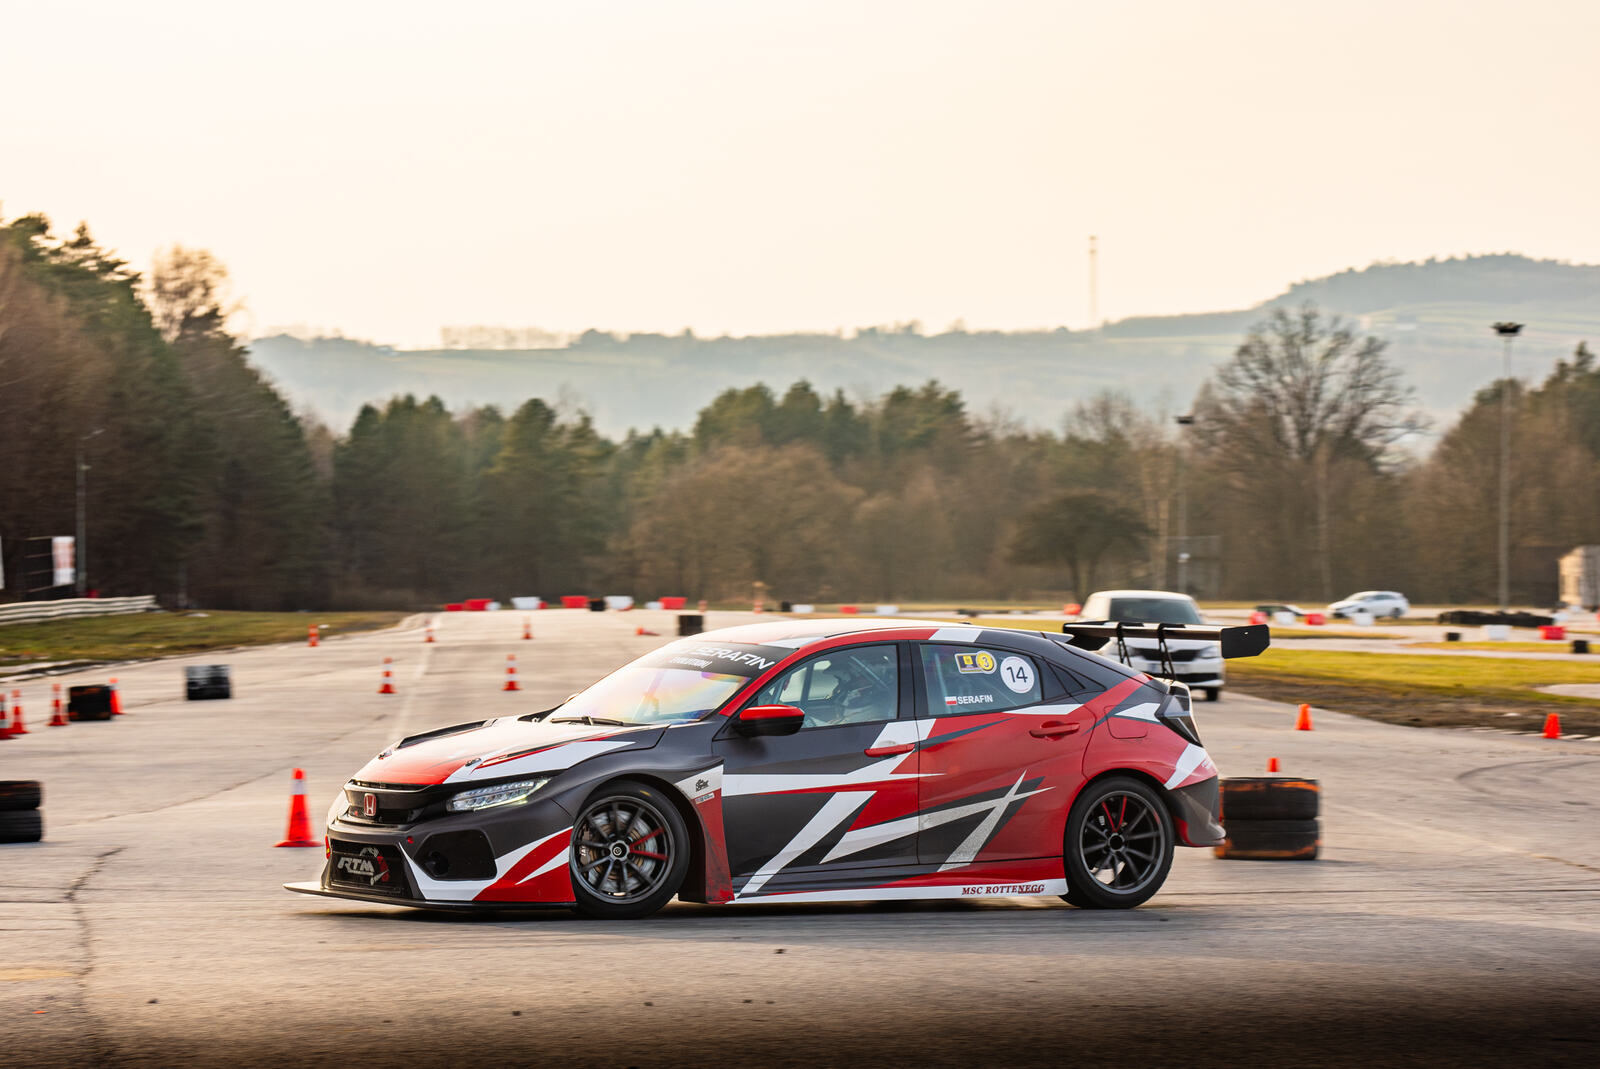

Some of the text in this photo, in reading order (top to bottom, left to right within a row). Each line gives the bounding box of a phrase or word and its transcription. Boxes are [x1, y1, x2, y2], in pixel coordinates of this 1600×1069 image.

[982, 656, 990, 668] 3
[1006, 666, 1028, 683] 14
[957, 694, 993, 705] SERAFIN
[337, 857, 375, 876] RTM
[962, 884, 1045, 895] MSC ROTTENEGG
